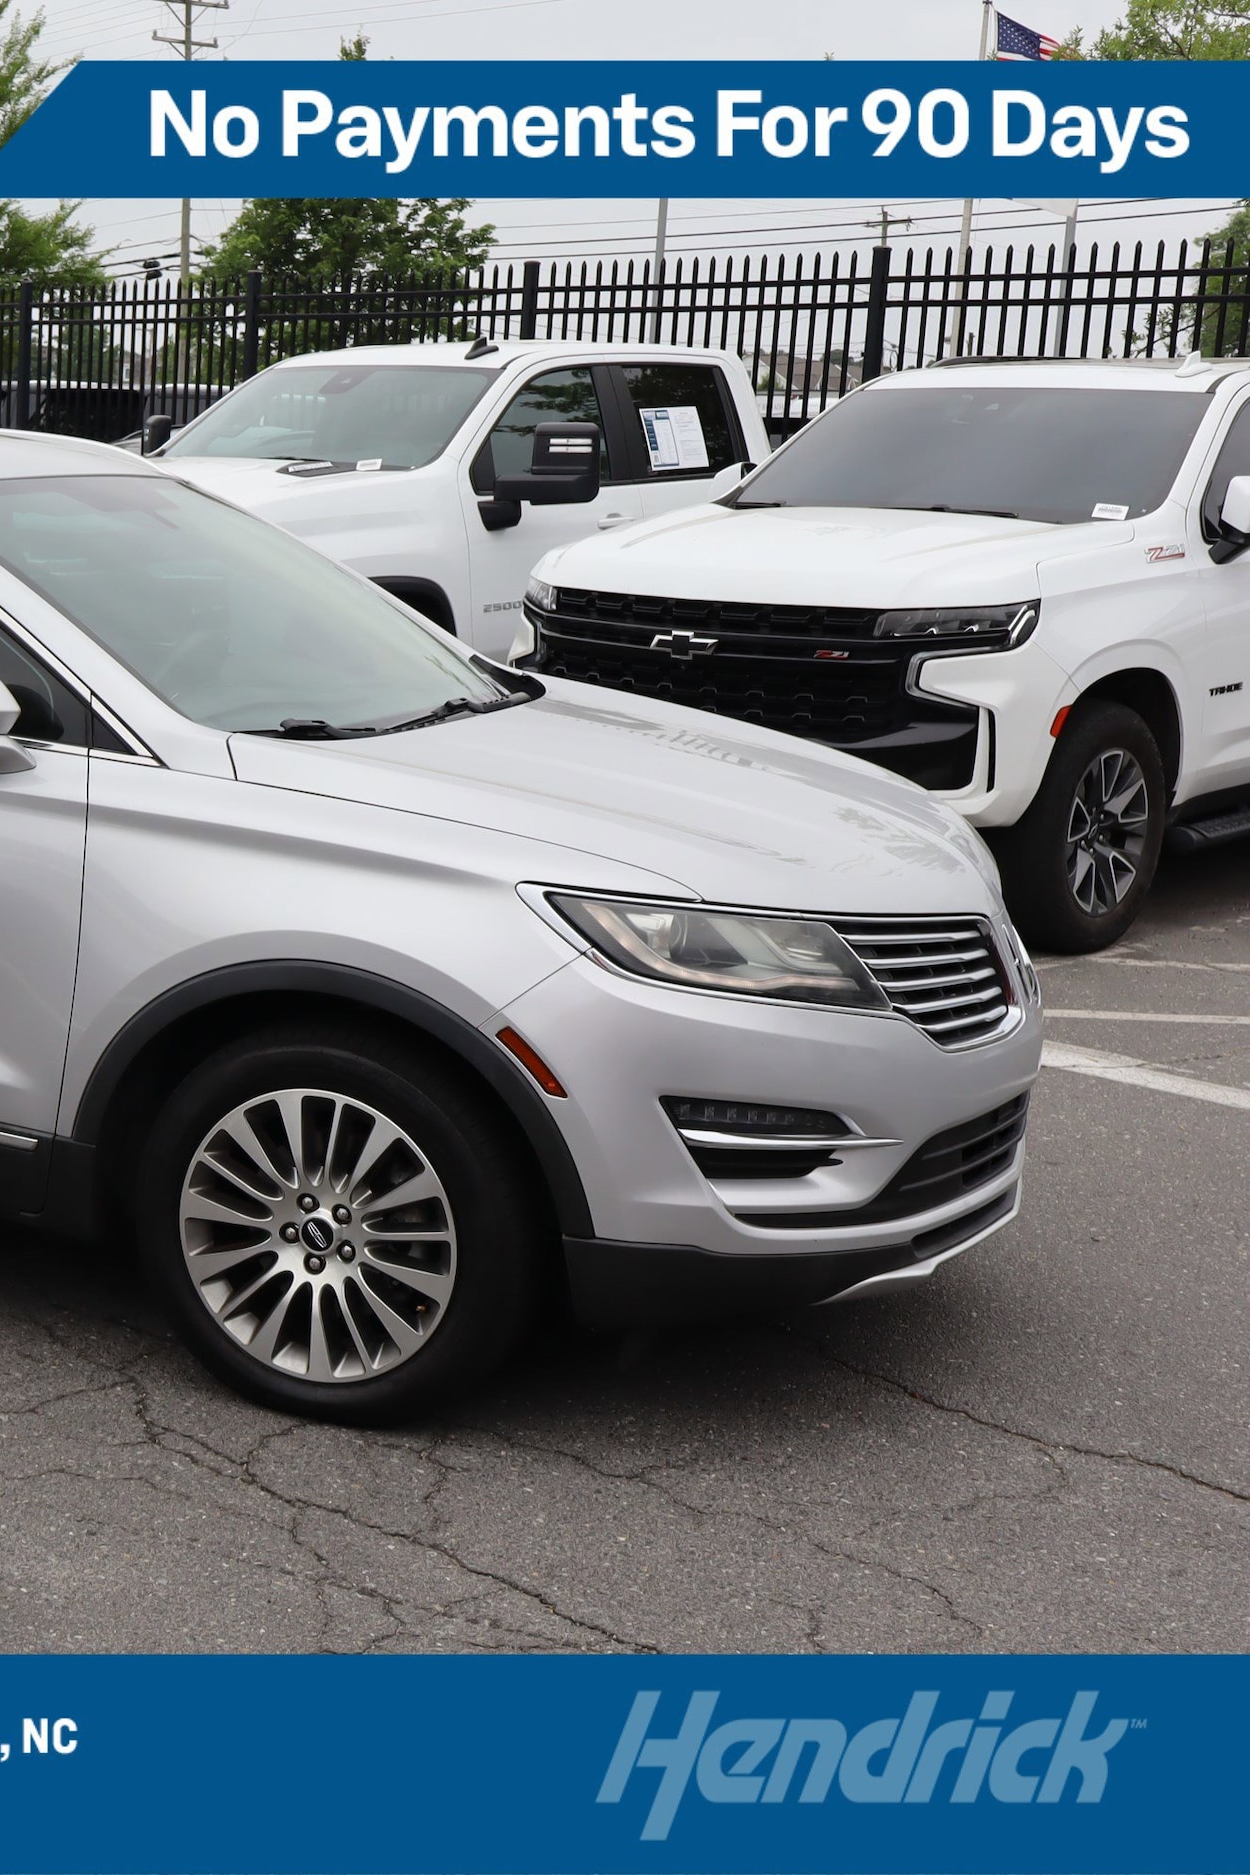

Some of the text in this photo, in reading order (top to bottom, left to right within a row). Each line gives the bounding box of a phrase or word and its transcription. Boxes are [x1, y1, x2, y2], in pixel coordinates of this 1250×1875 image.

[1144, 543, 1186, 563] Z71
[483, 600, 523, 613] 2500
[1209, 682, 1244, 697] TAHOE
